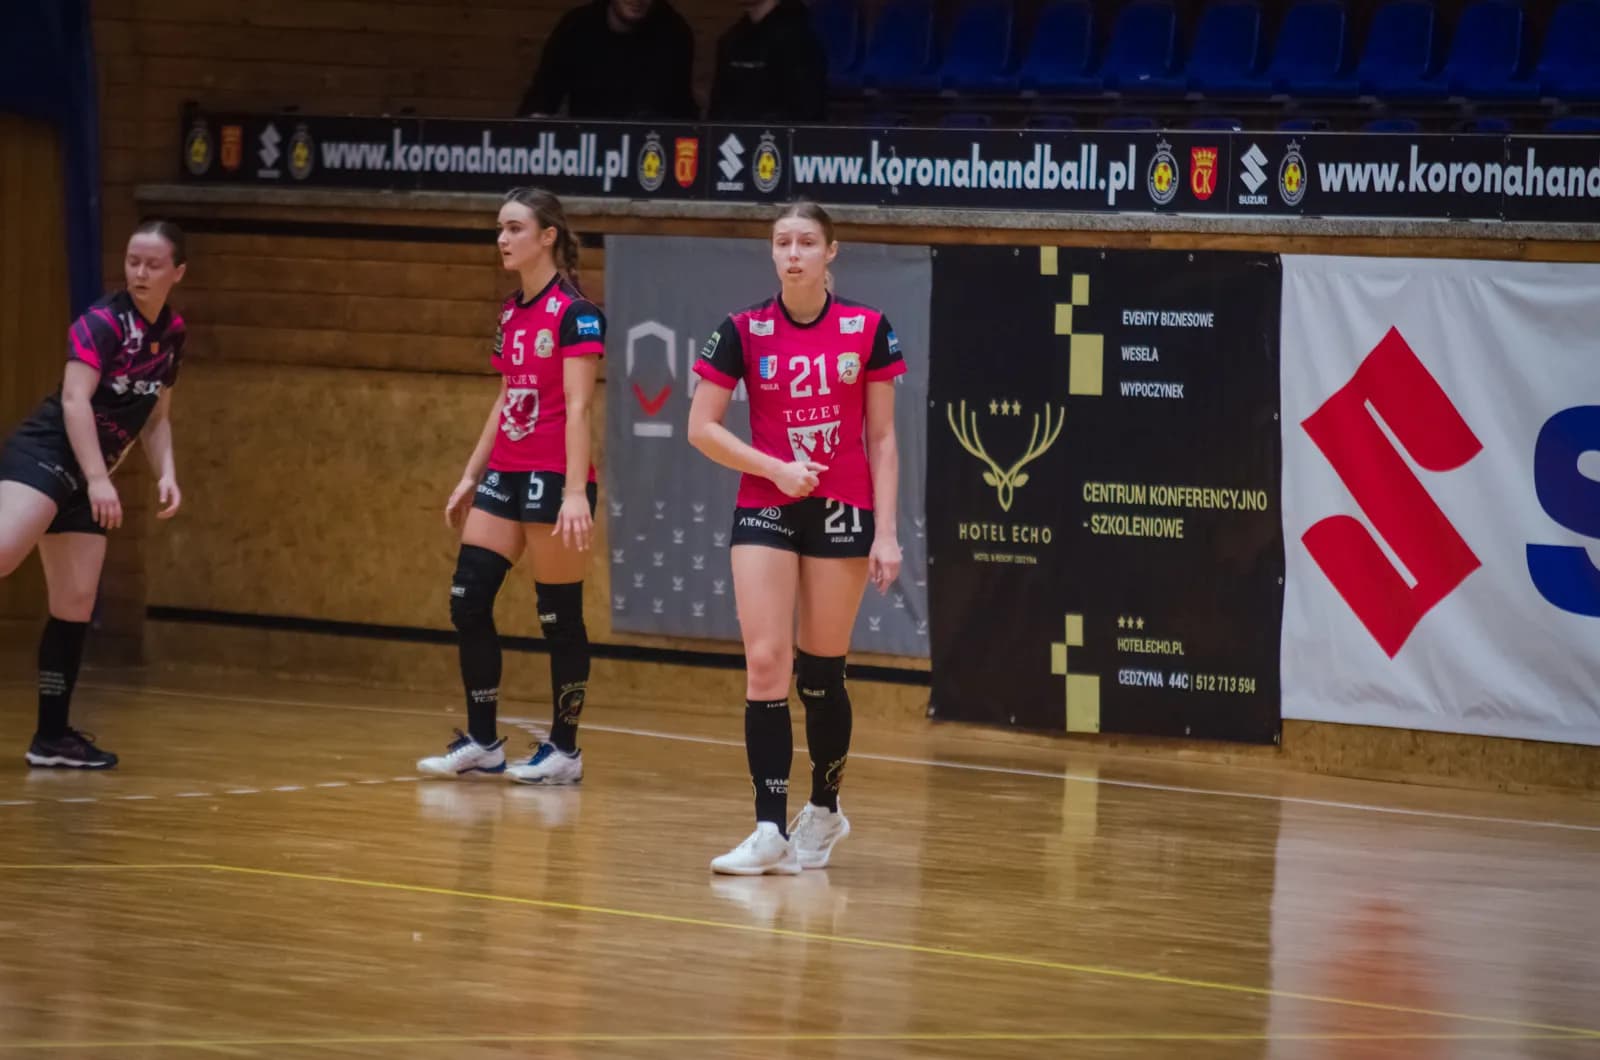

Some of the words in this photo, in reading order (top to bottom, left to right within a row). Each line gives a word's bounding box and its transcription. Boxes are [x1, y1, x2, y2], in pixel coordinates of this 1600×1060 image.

[321, 129, 629, 191] www.koronahandball.pl
[793, 140, 1136, 205] www.koronahandball.pl
[1238, 195, 1268, 205] SUZUKI
[1122, 311, 1159, 326] EVENTY
[1160, 312, 1214, 328] BIZNESOWE
[512, 329, 526, 366] 5
[1121, 346, 1159, 362] WESELA
[788, 353, 831, 398] 21
[1120, 382, 1184, 399] WYPOCZYNEK
[783, 404, 841, 423] TCZEW
[1083, 482, 1147, 506] CENTRUM
[1149, 486, 1268, 512] KONFERENCYJNO
[824, 497, 863, 534] 21
[1091, 515, 1184, 540] SZKOLENIOWE
[959, 523, 1007, 543] HOTEL
[1012, 526, 1052, 544] ECHO
[1117, 637, 1185, 656] HOTELECHO.PL
[1118, 669, 1164, 688] CEDZYNA
[1168, 672, 1189, 689] 44C
[1196, 675, 1215, 691] 512
[1218, 677, 1237, 693] 713
[1238, 678, 1256, 695] 594
